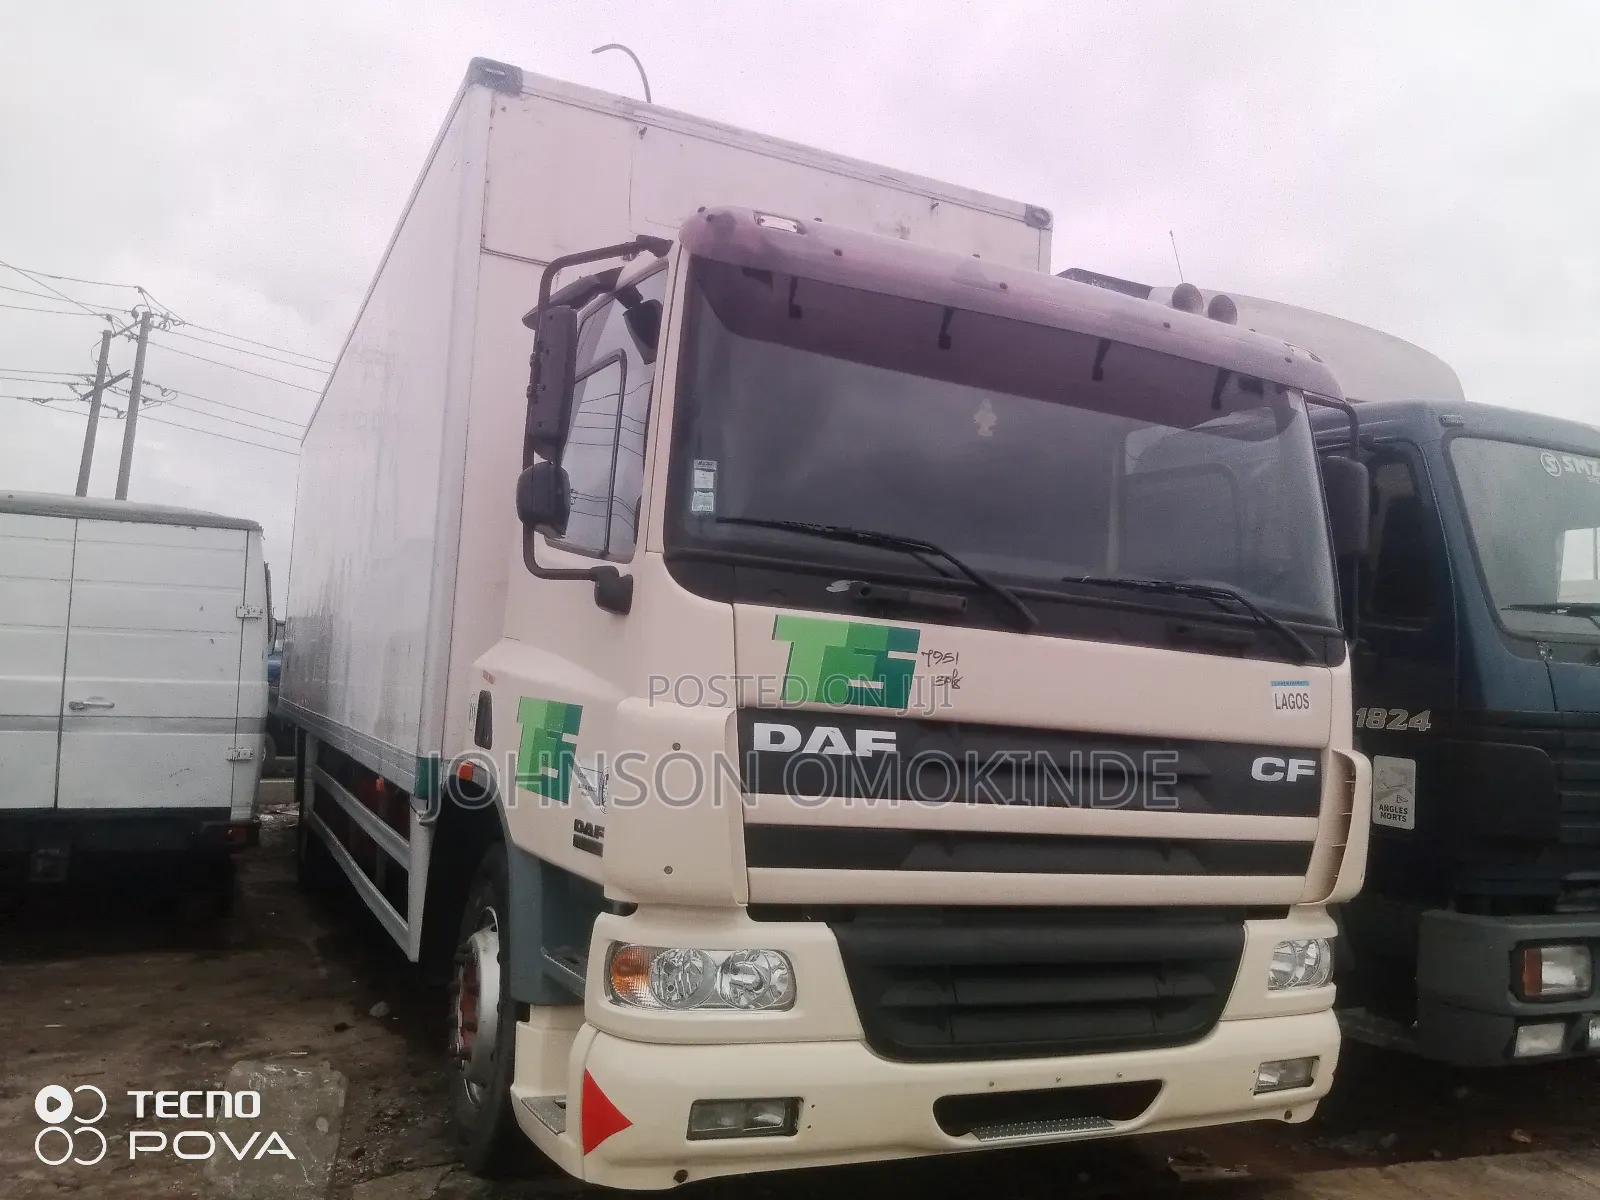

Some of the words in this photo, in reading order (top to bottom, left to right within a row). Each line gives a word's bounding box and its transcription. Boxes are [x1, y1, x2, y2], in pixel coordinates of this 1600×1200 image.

[921, 649, 959, 667] 7951
[1274, 692, 1310, 710] LAGOS
[1355, 707, 1432, 732] 1824
[753, 722, 897, 758] DAF
[1251, 756, 1317, 782] CF
[1379, 803, 1408, 815] ANGLES
[1380, 811, 1407, 823] MORTS
[573, 818, 606, 839] DAF
